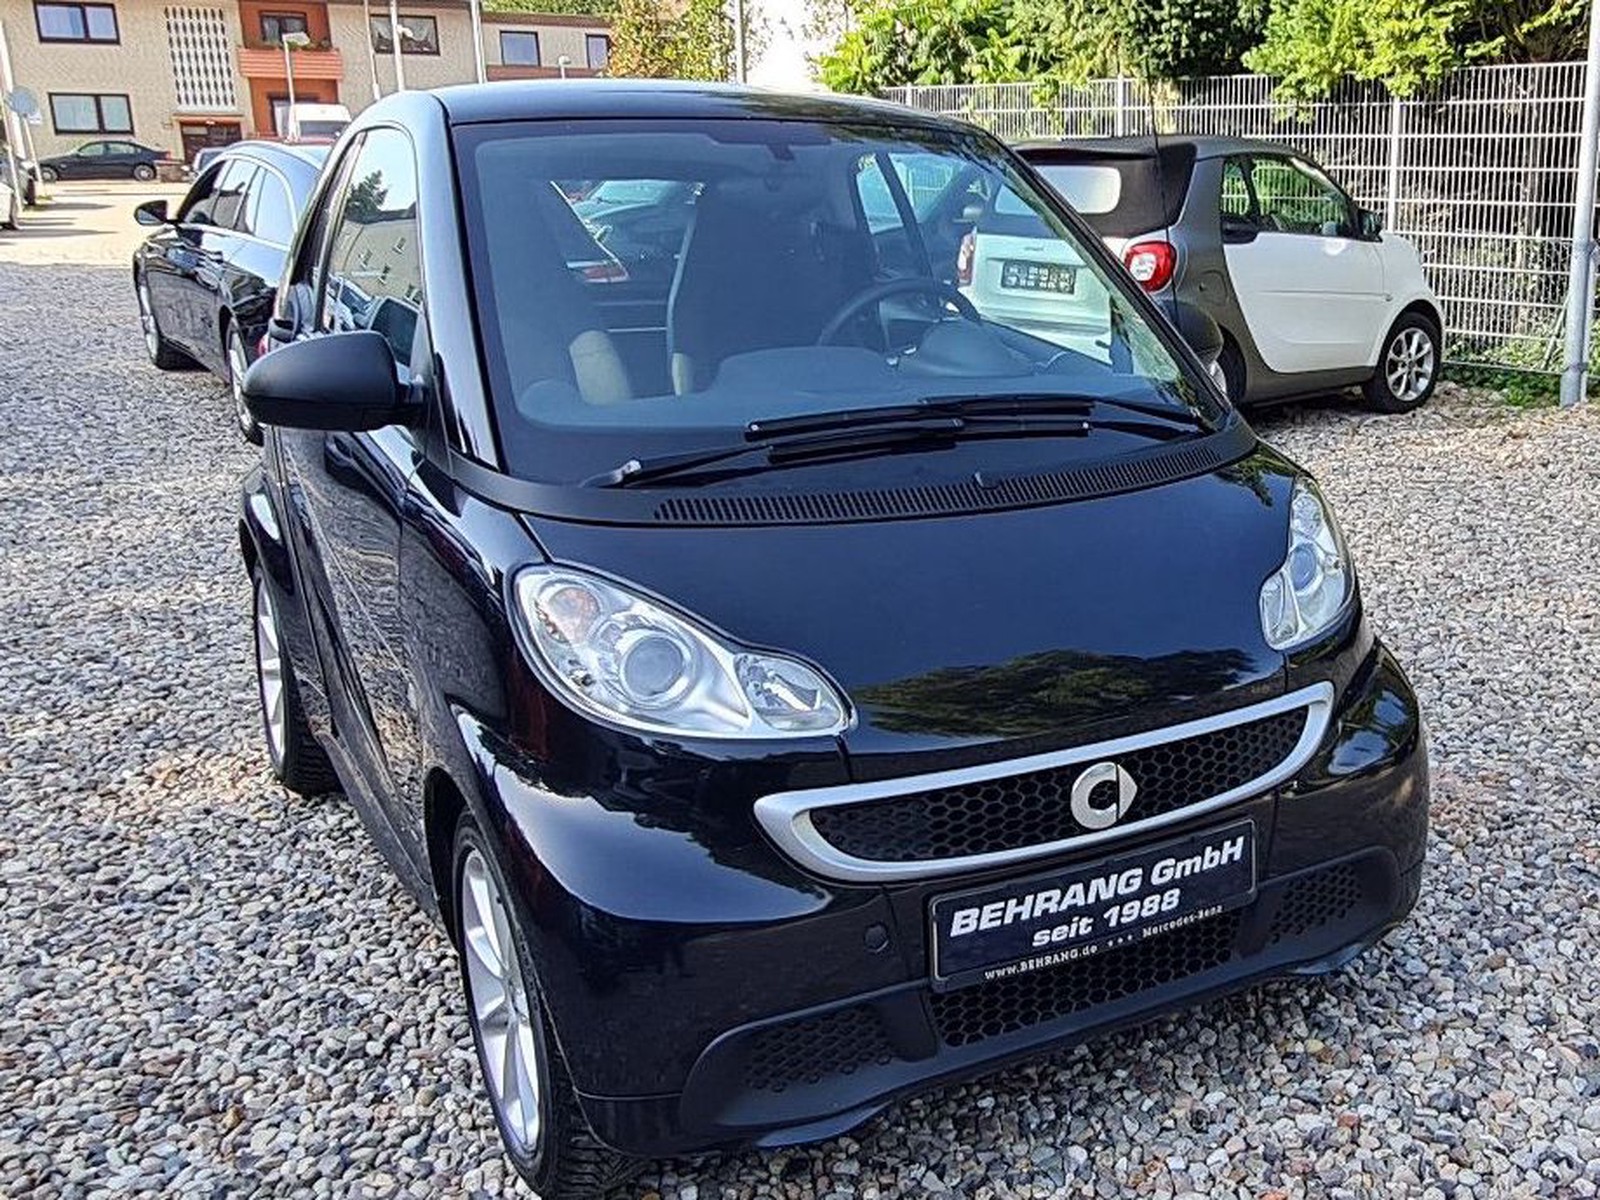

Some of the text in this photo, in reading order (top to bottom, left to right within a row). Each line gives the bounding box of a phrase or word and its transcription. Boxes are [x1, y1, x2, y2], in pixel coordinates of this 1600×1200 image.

[950, 836, 1245, 937] BEHRANG GmbH
[1032, 888, 1181, 946] seit 1988
[984, 905, 1223, 980] www.BEHRANG.de Mercedes-Benz
